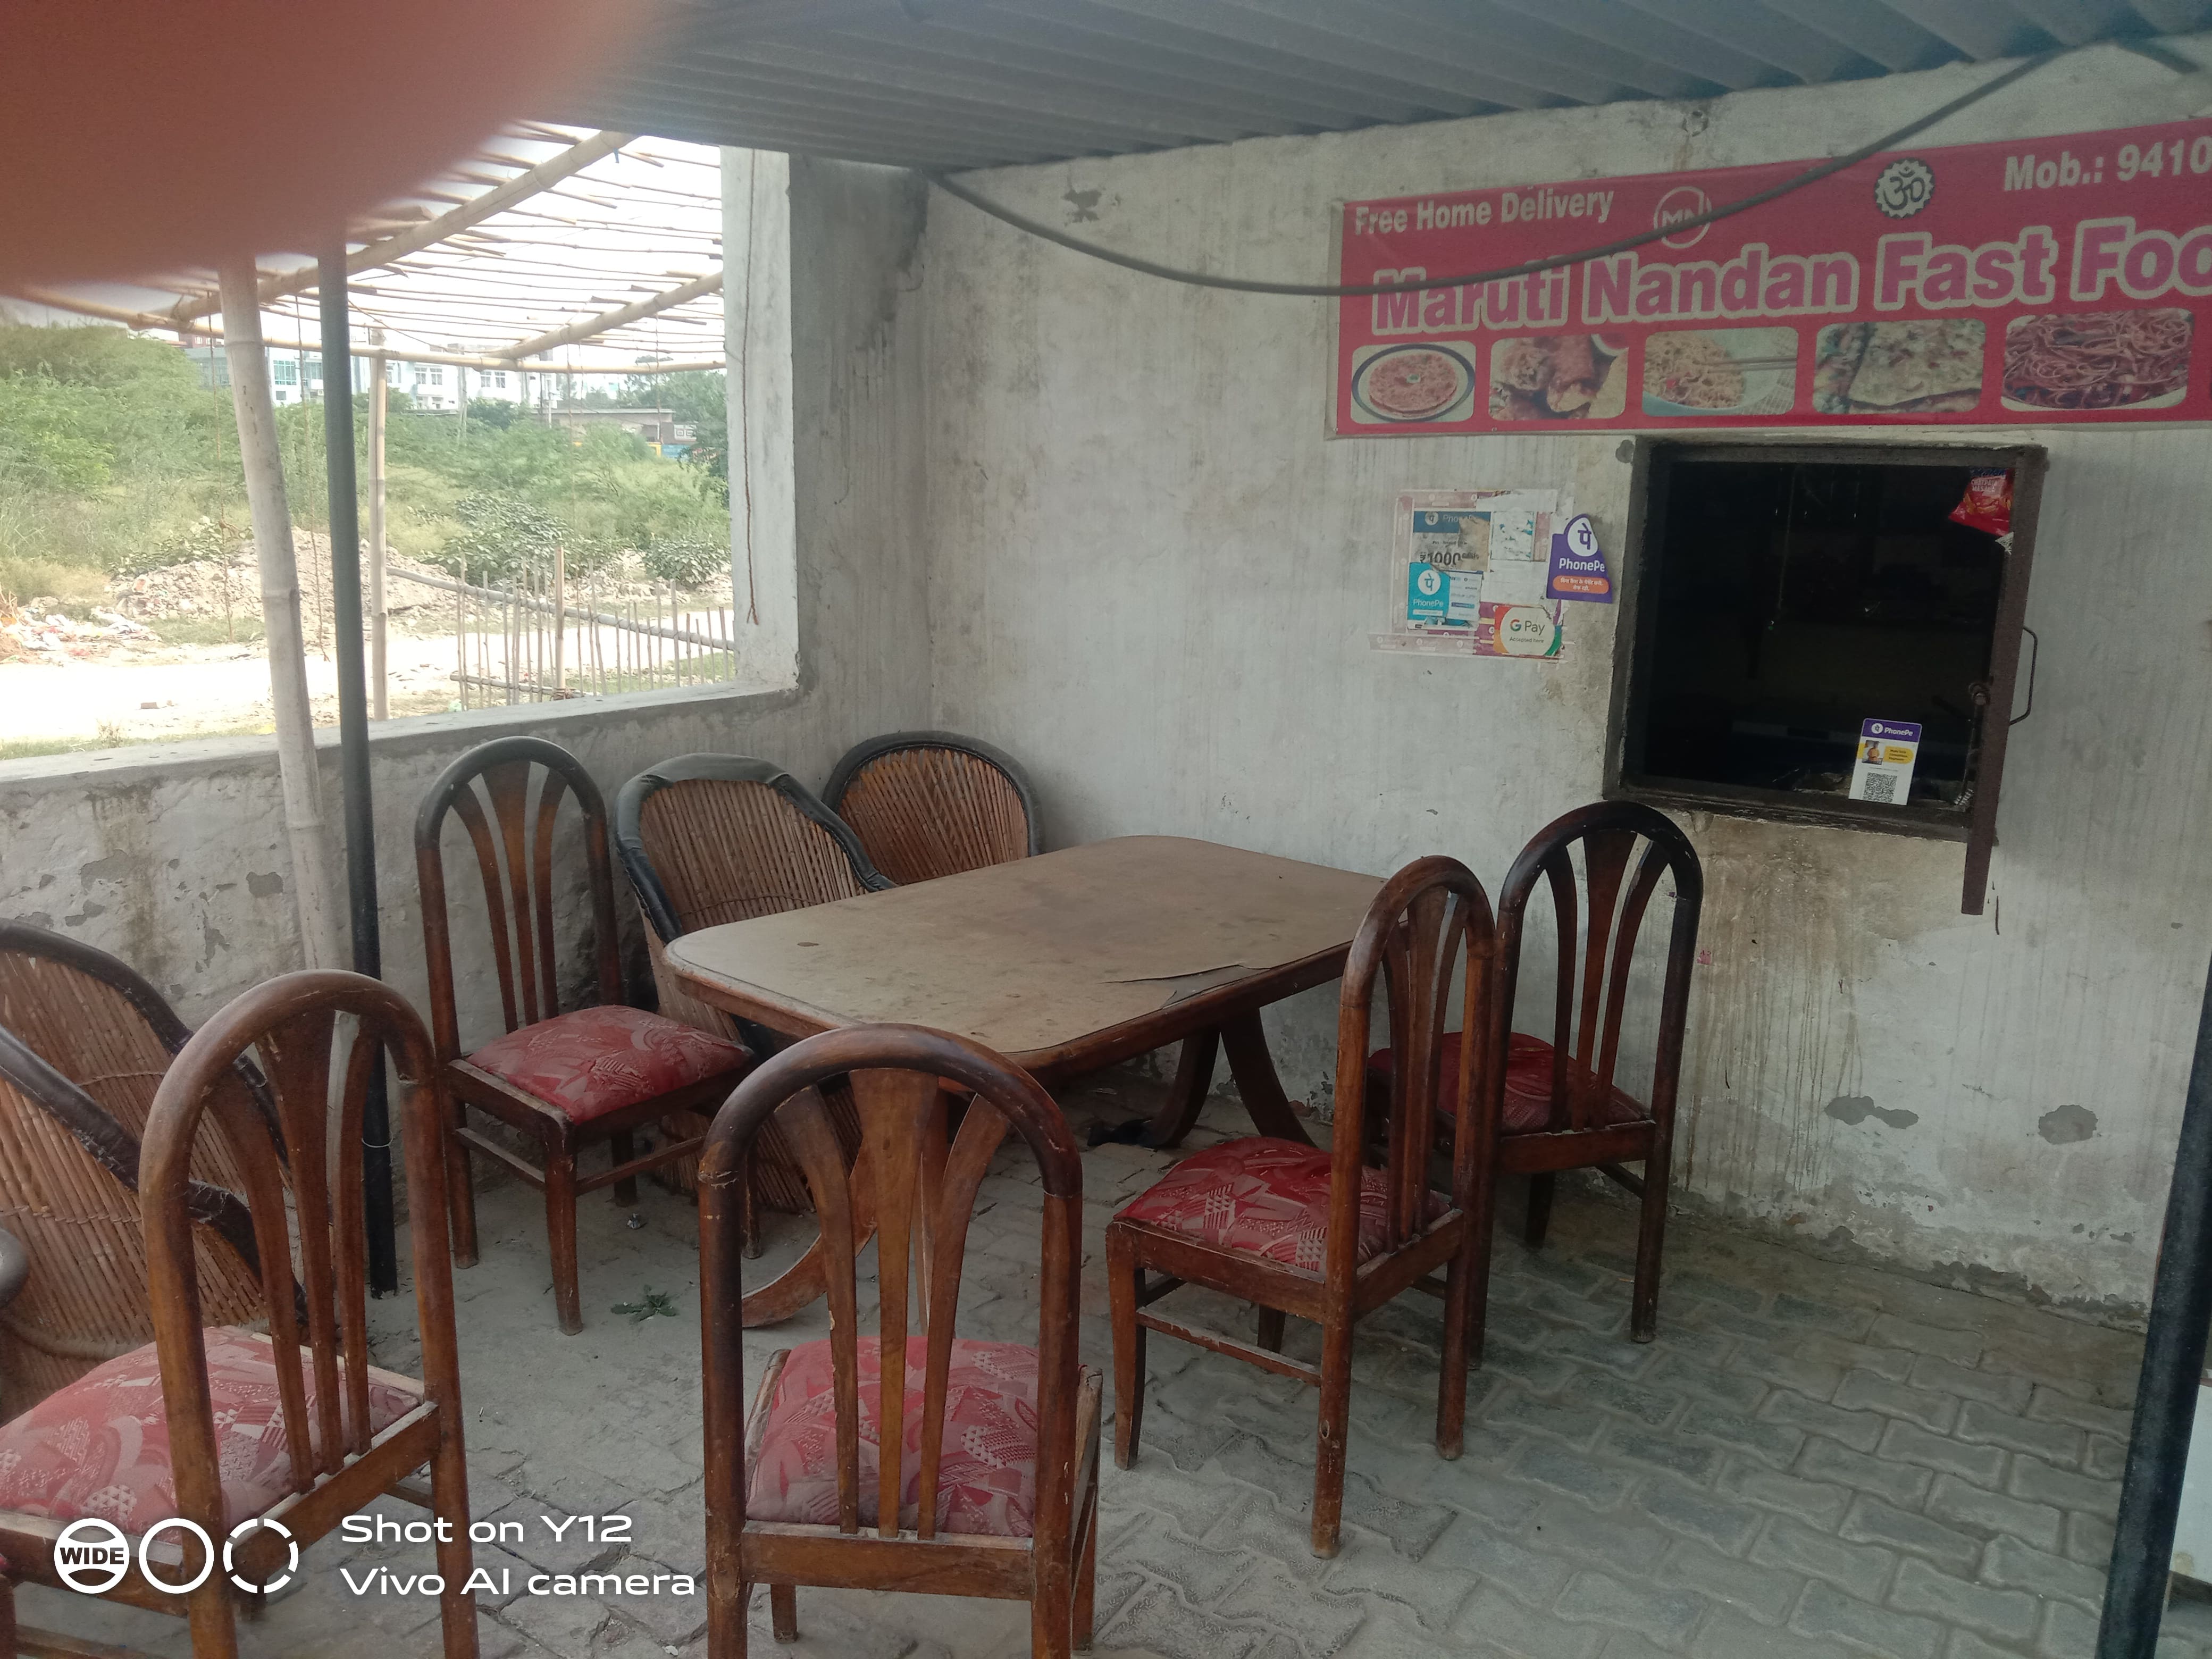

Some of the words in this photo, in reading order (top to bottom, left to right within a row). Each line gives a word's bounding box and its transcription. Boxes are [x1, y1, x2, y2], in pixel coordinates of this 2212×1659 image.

[2003, 152, 2104, 192] Mob.:
[2118, 135, 2212, 180] 9410
[1354, 206, 1407, 236] Free
[1416, 199, 1493, 231] Home
[1501, 187, 1615, 227] Delivery
[1372, 256, 1571, 336] Maruti
[1581, 242, 1860, 324] Nandan
[1873, 225, 2059, 311] Fast
[1559, 557, 1605, 572] PhonePe
[1413, 598, 1444, 607] PhonePe
[1524, 620, 1545, 635] Pay
[1884, 727, 1913, 736] PhonePe
